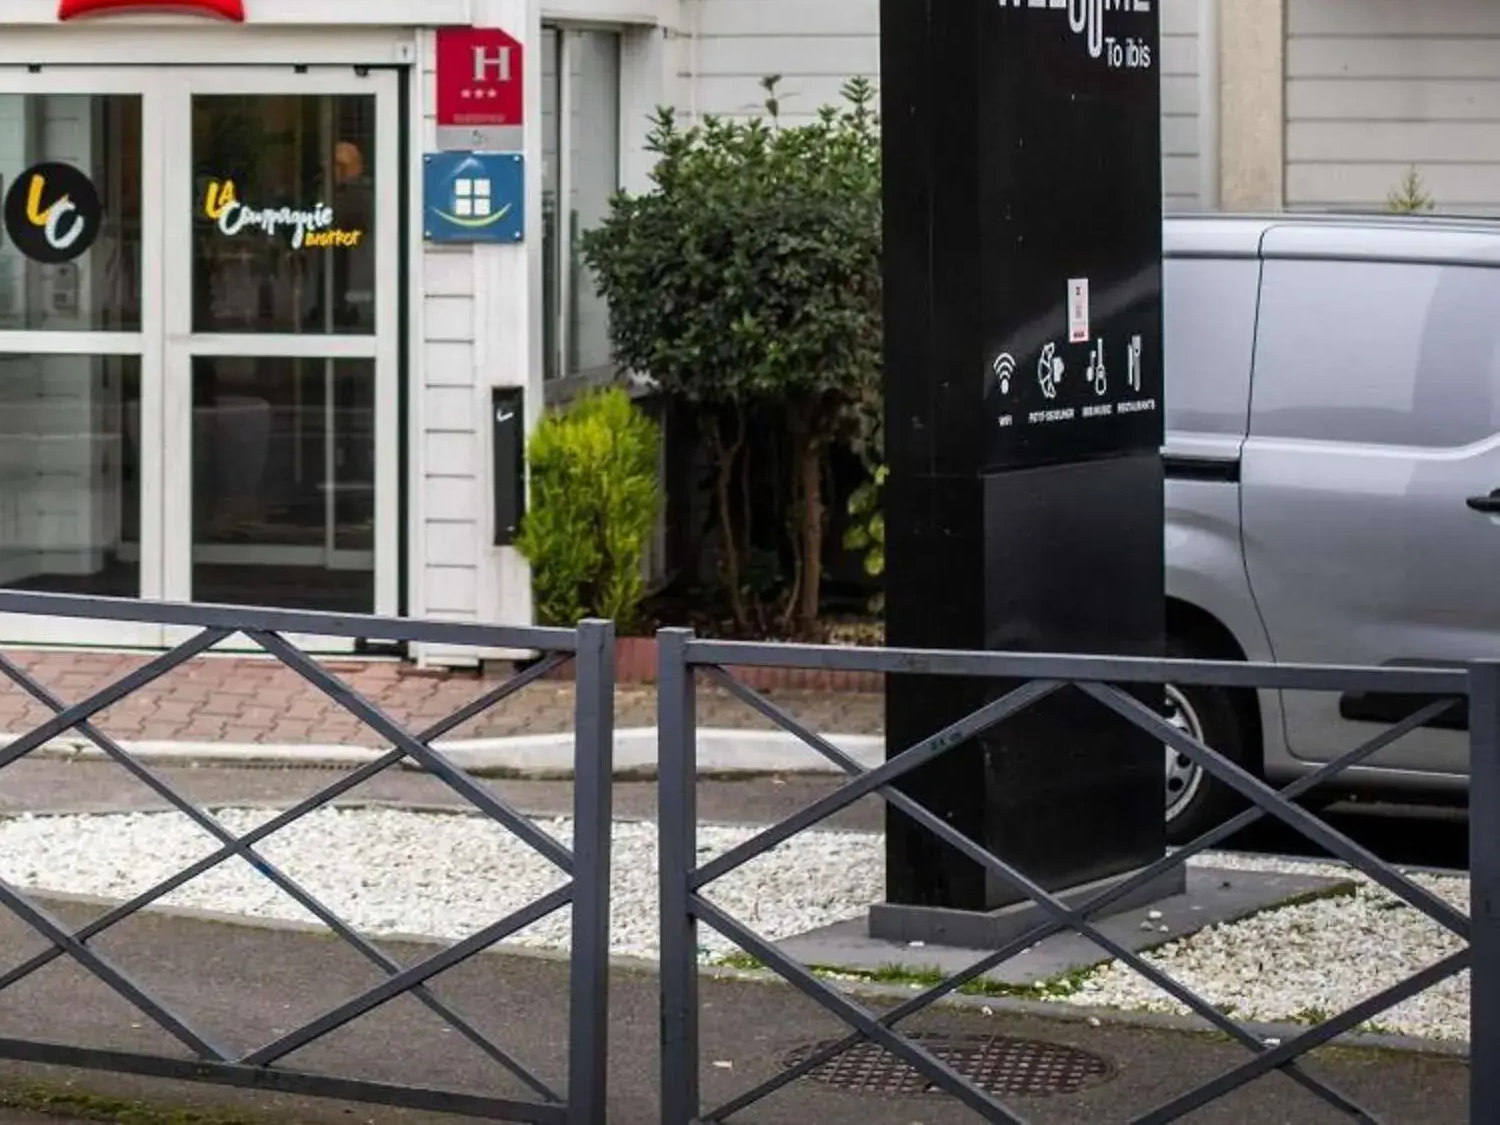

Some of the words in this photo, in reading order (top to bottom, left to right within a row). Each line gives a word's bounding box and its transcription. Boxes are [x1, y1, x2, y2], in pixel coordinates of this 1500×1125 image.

[470, 44, 512, 82] H
[1104, 37, 1123, 68] To
[1125, 38, 1151, 68] ibis
[219, 202, 334, 250] Compagnie
